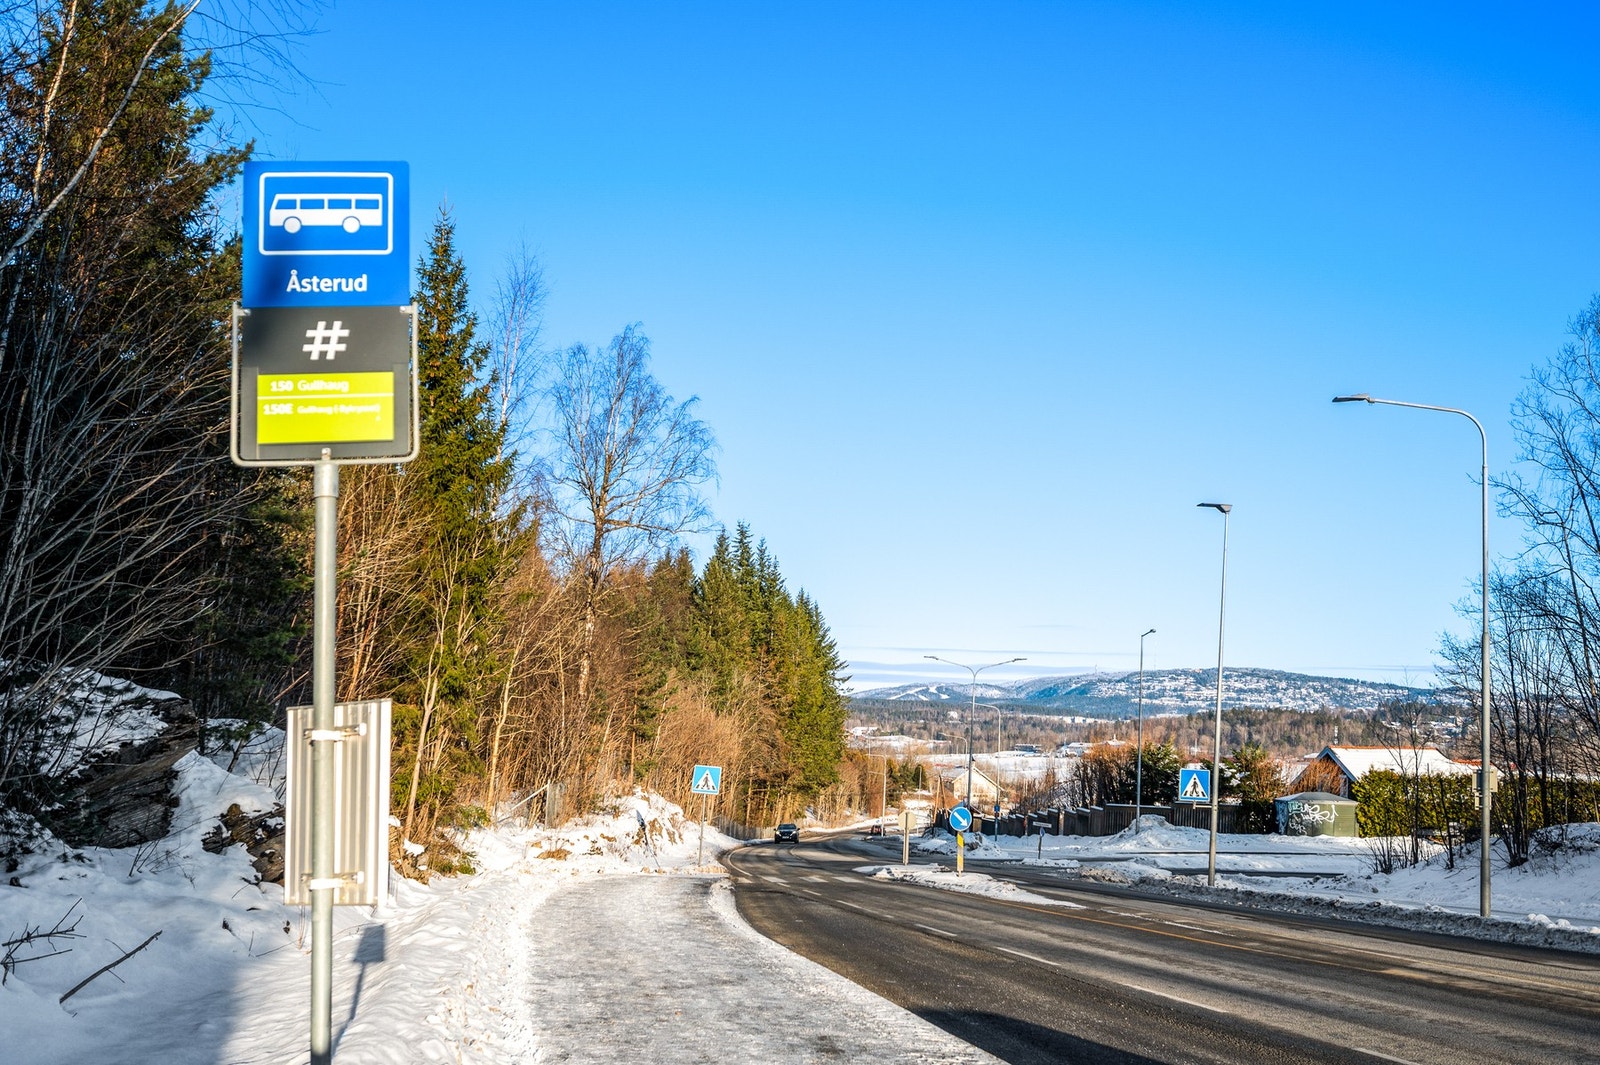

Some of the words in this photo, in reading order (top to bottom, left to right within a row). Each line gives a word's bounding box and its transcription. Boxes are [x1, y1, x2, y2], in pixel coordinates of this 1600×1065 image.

[286, 269, 369, 293] Åsterud
[271, 380, 293, 392] 150
[297, 379, 349, 393] Gullhaug
[264, 403, 293, 415] 150E
